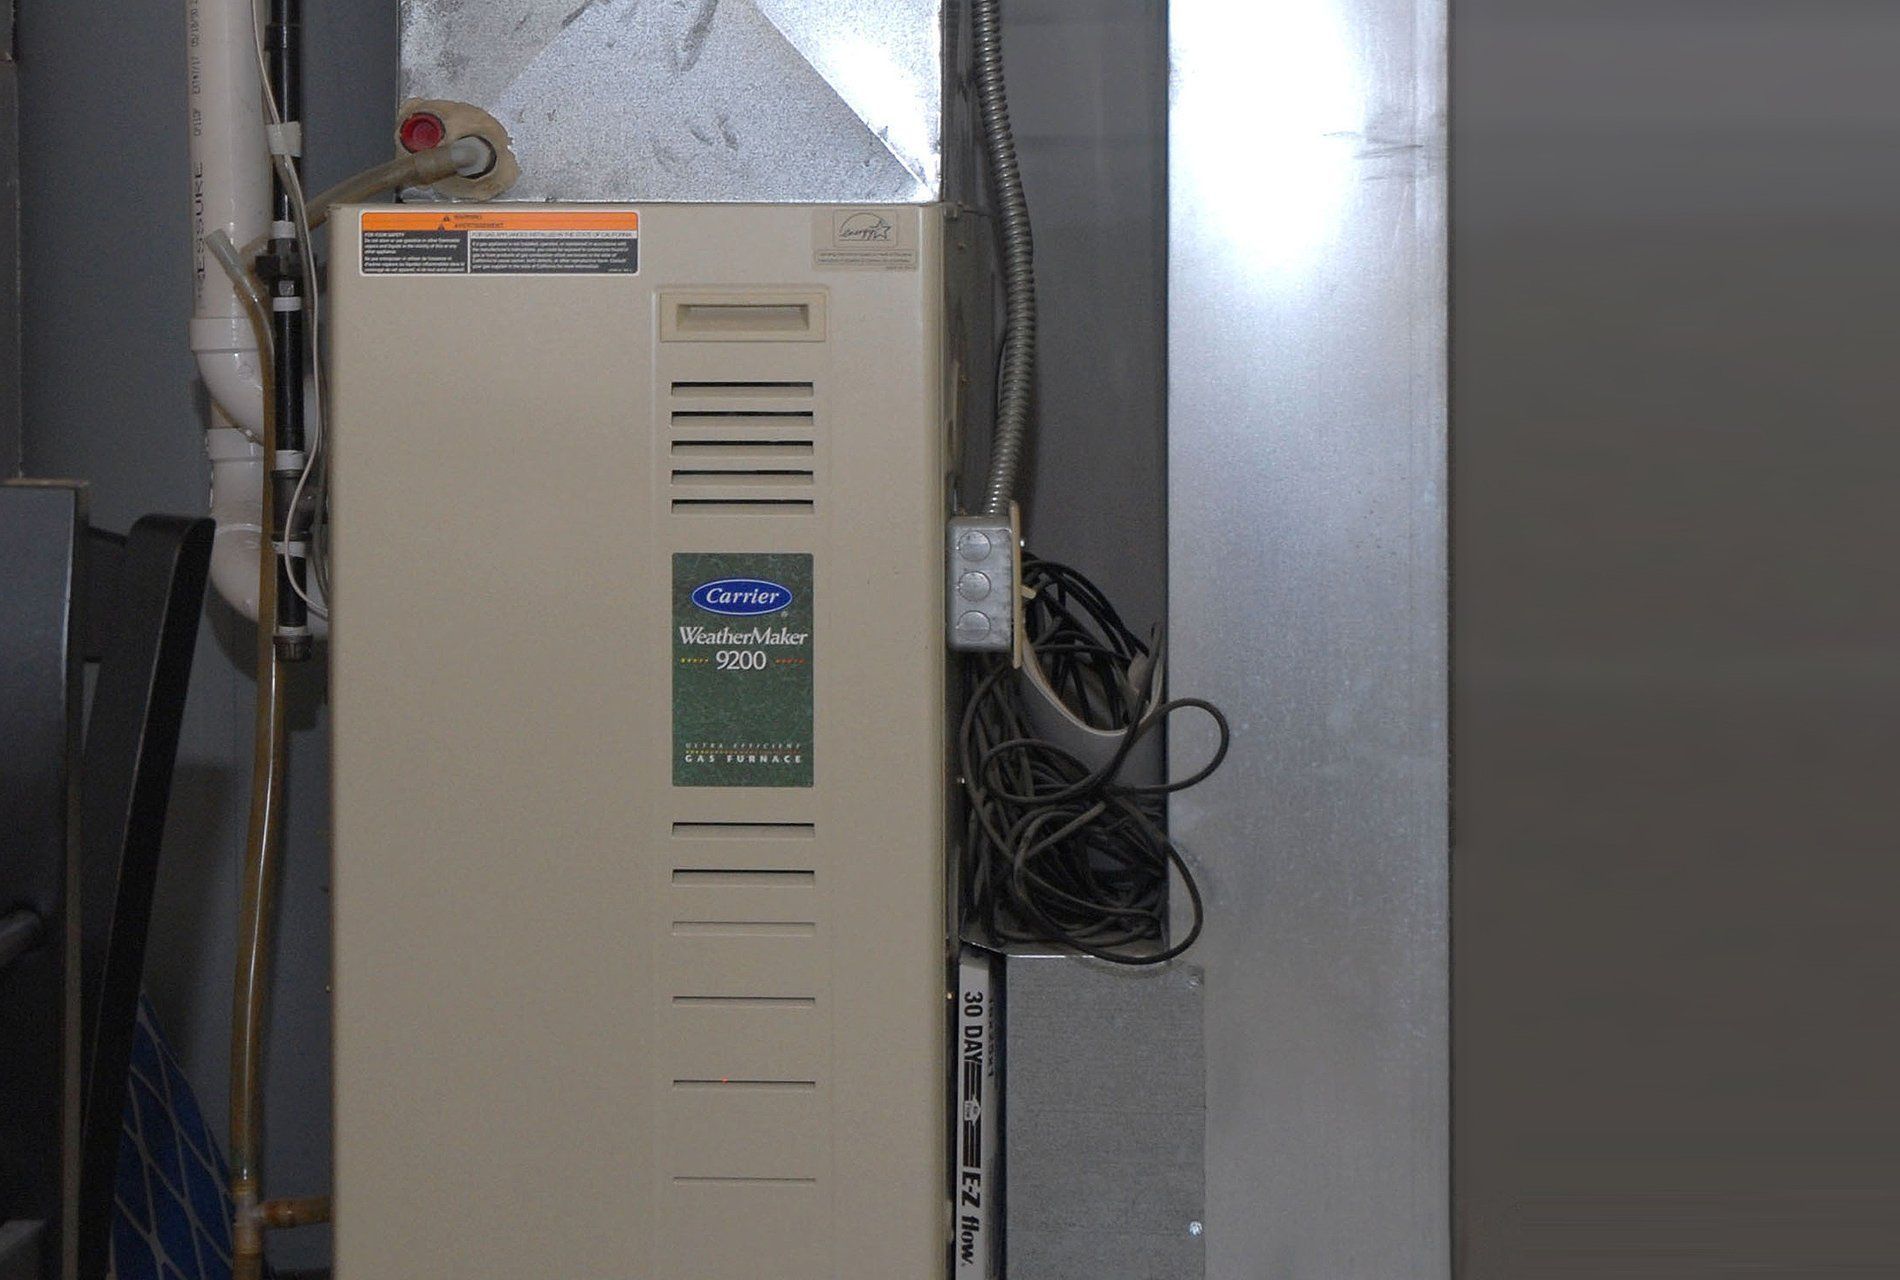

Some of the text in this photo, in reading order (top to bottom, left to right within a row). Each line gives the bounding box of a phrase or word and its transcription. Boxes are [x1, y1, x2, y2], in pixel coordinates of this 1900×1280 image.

[706, 588, 780, 604] Carrier
[679, 626, 808, 645] WeatherMaker
[716, 650, 767, 670] 9200
[685, 755, 801, 764] GAS FURNACE
[964, 991, 983, 1064] 30 DAY
[962, 1171, 981, 1209] E-Z
